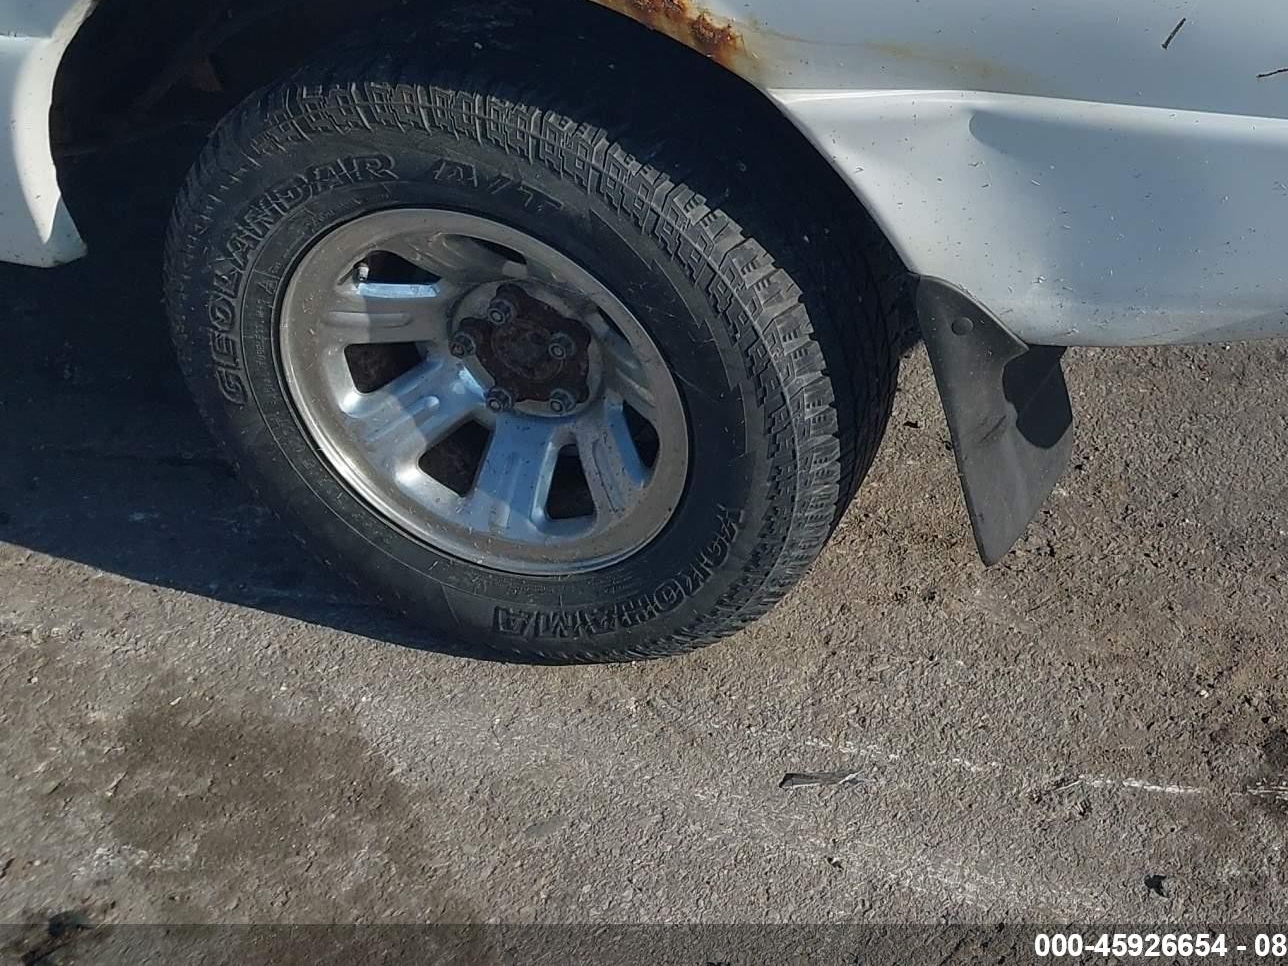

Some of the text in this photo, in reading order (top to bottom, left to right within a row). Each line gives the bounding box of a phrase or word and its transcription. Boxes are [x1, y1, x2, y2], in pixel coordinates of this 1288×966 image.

[209, 154, 399, 407] GEOLANDAR
[432, 158, 562, 210] A/T
[493, 504, 744, 636] YOKOHAMA
